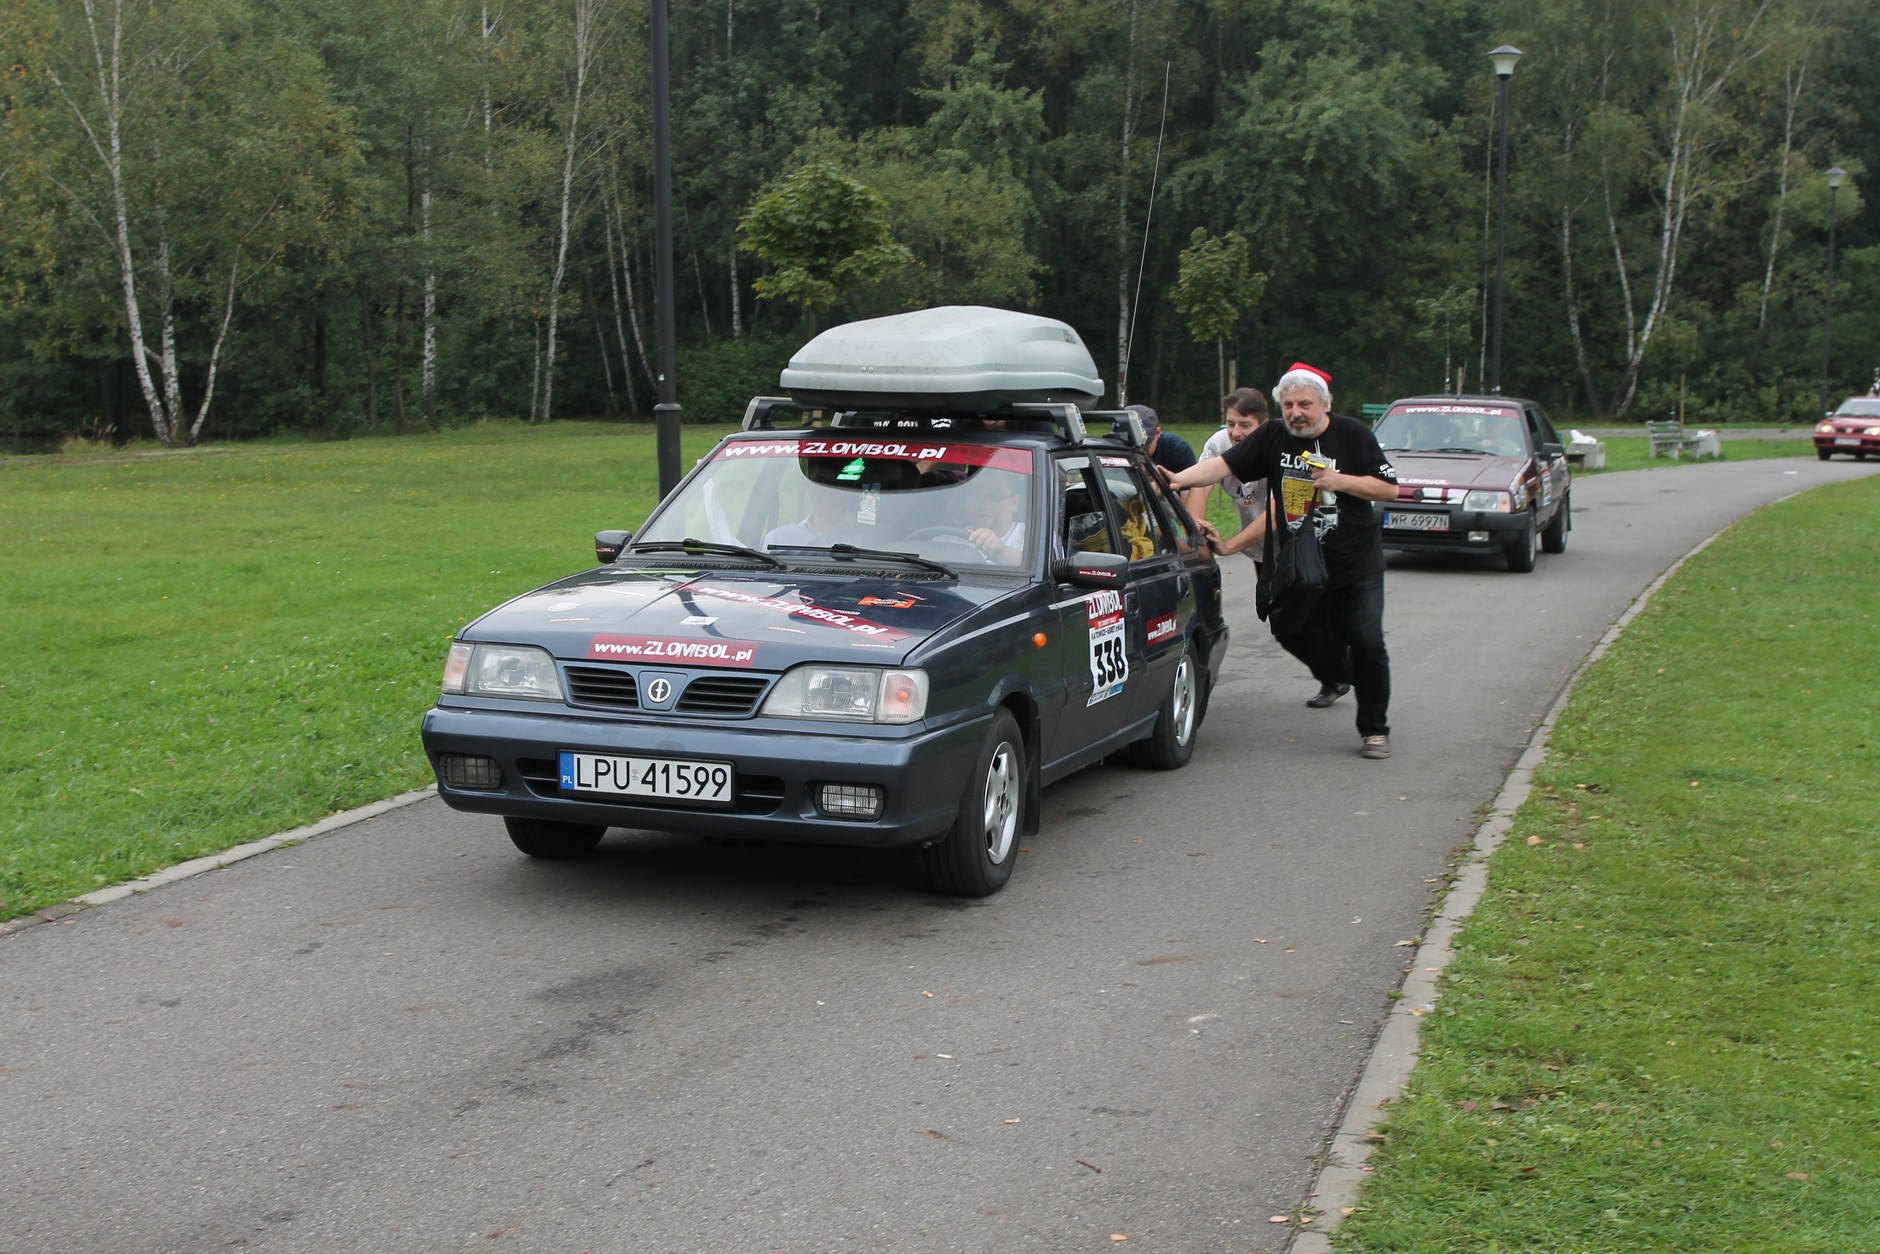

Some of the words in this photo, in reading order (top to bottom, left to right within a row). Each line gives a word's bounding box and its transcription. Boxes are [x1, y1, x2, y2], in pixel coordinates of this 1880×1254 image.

[1405, 405, 1502, 416] www.ZLOMBOL.pl
[725, 441, 947, 459] www.ZLOMBOL.pl
[1280, 452, 1340, 473] ZLOMOL
[1391, 514, 1408, 526] WR
[699, 587, 889, 635] www.ZLOMBOL.pl
[1086, 590, 1123, 620] ZLOMBOL
[594, 640, 752, 661] www.ZLOMBOL.pl
[1094, 636, 1125, 687] 338
[562, 775, 573, 784] PL
[577, 757, 630, 790] LPU
[641, 763, 728, 798] 41599
